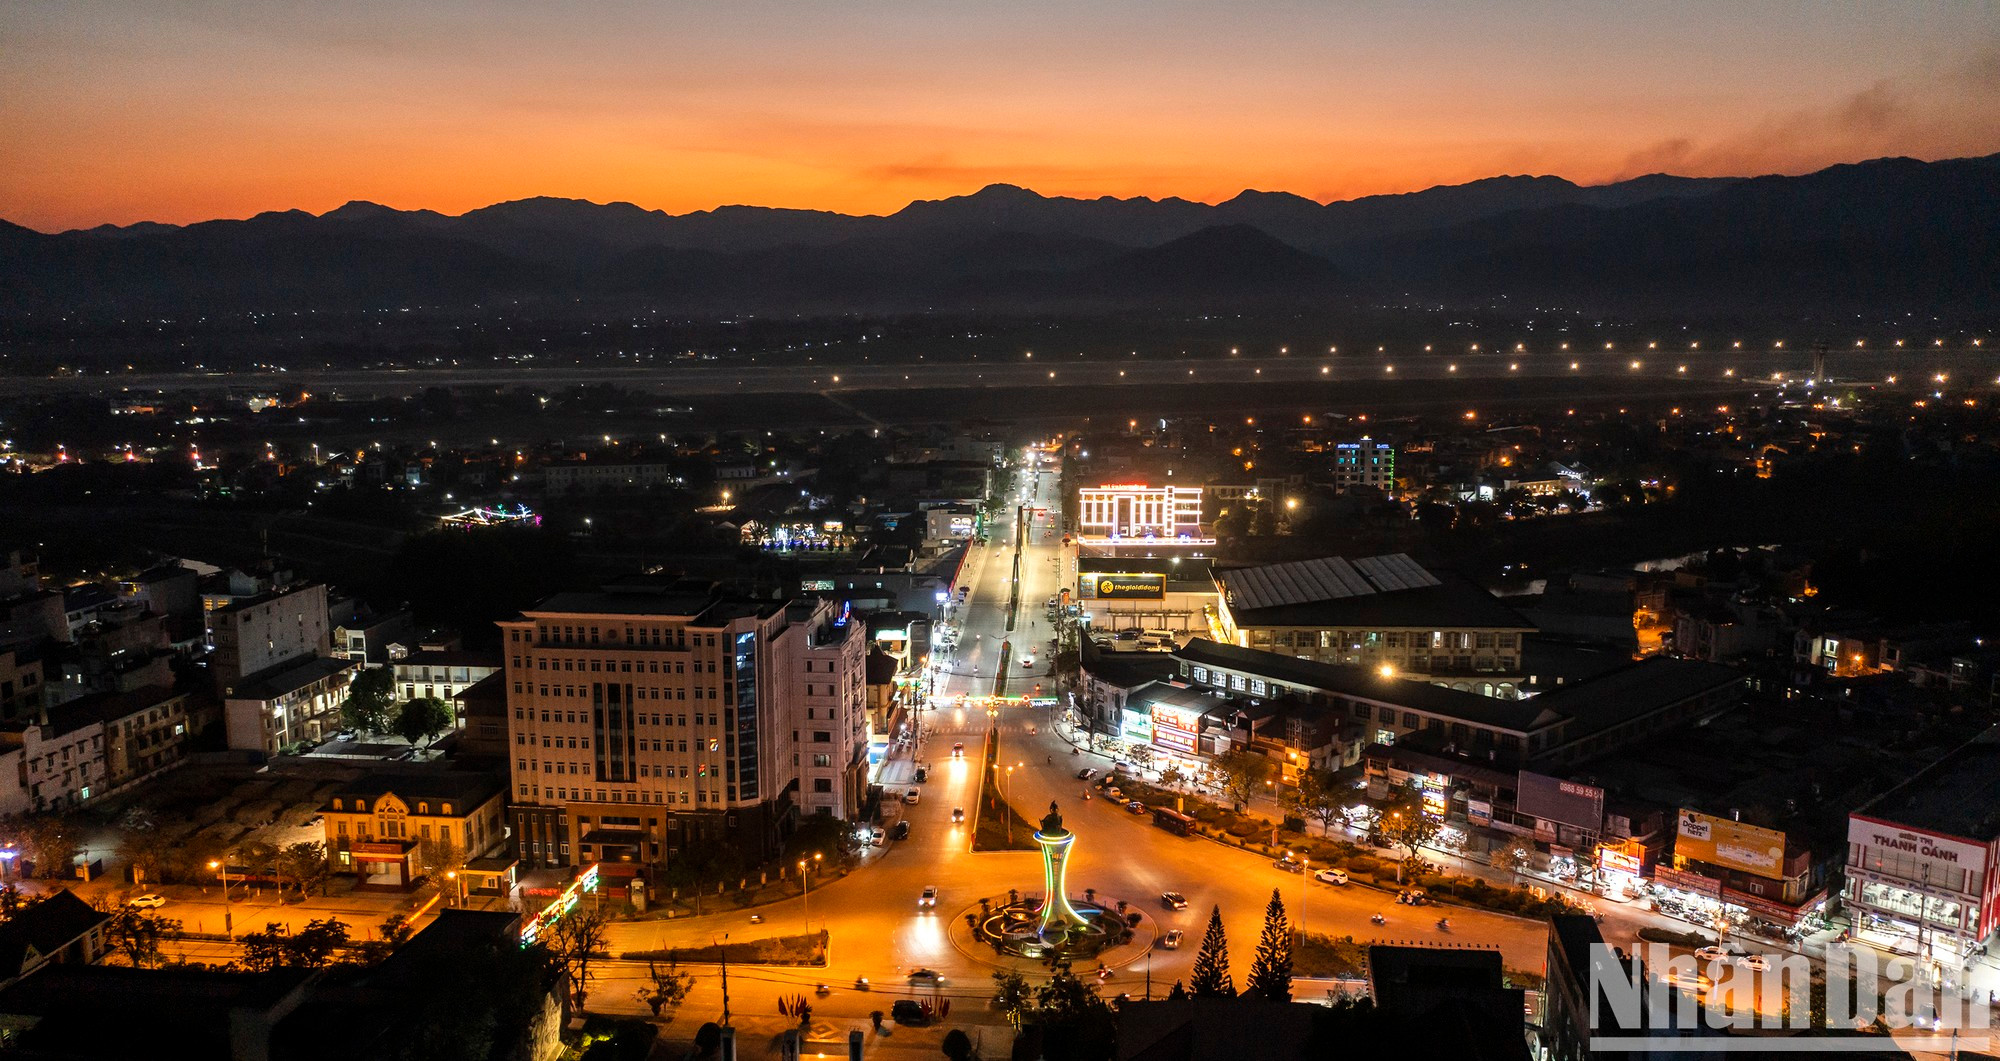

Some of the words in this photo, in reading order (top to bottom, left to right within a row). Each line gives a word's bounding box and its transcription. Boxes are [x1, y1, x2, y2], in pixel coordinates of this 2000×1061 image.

[1682, 820, 1708, 832] Doppel
[1687, 827, 1703, 837] herz
[1919, 837, 1934, 847] THỊ
[1873, 834, 1917, 853] THANH
[1921, 846, 1958, 862] OÁNH
